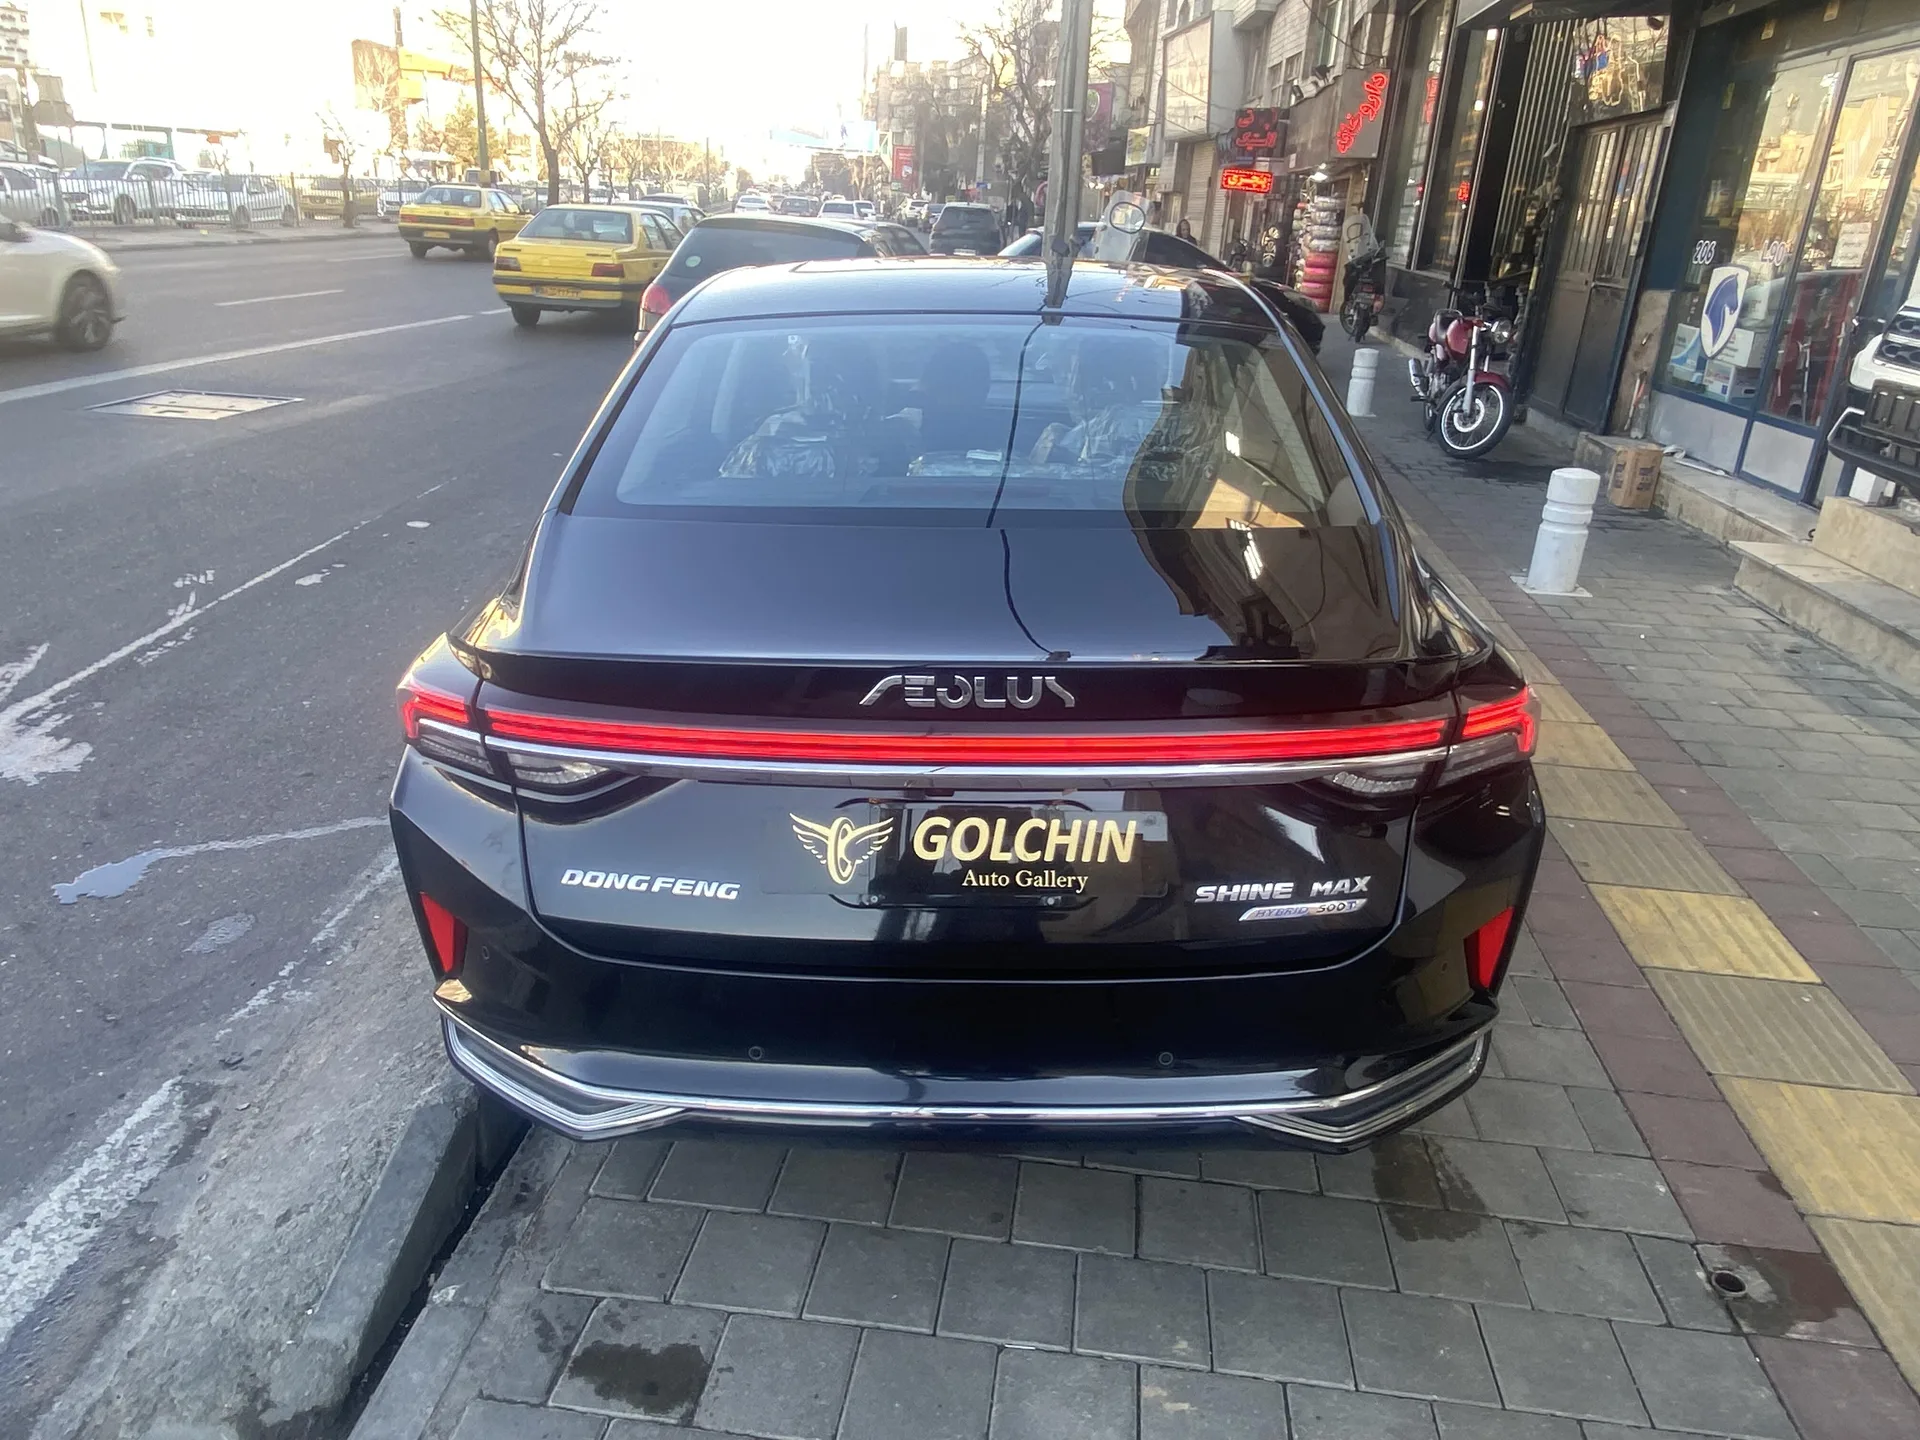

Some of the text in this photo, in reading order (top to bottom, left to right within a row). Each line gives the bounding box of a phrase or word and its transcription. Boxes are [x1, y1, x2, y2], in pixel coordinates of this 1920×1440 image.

[1336, 72, 1387, 154] داروخانه
[1236, 131, 1278, 151] لاستیک
[1692, 239, 1716, 265] 206
[913, 816, 1137, 864] GOLCHIN
[561, 868, 741, 900] DONGFENG
[962, 869, 1089, 894] Auto Gallery
[1194, 875, 1372, 904] SHINE MAX
[1254, 900, 1357, 918] HYBRID 500T
